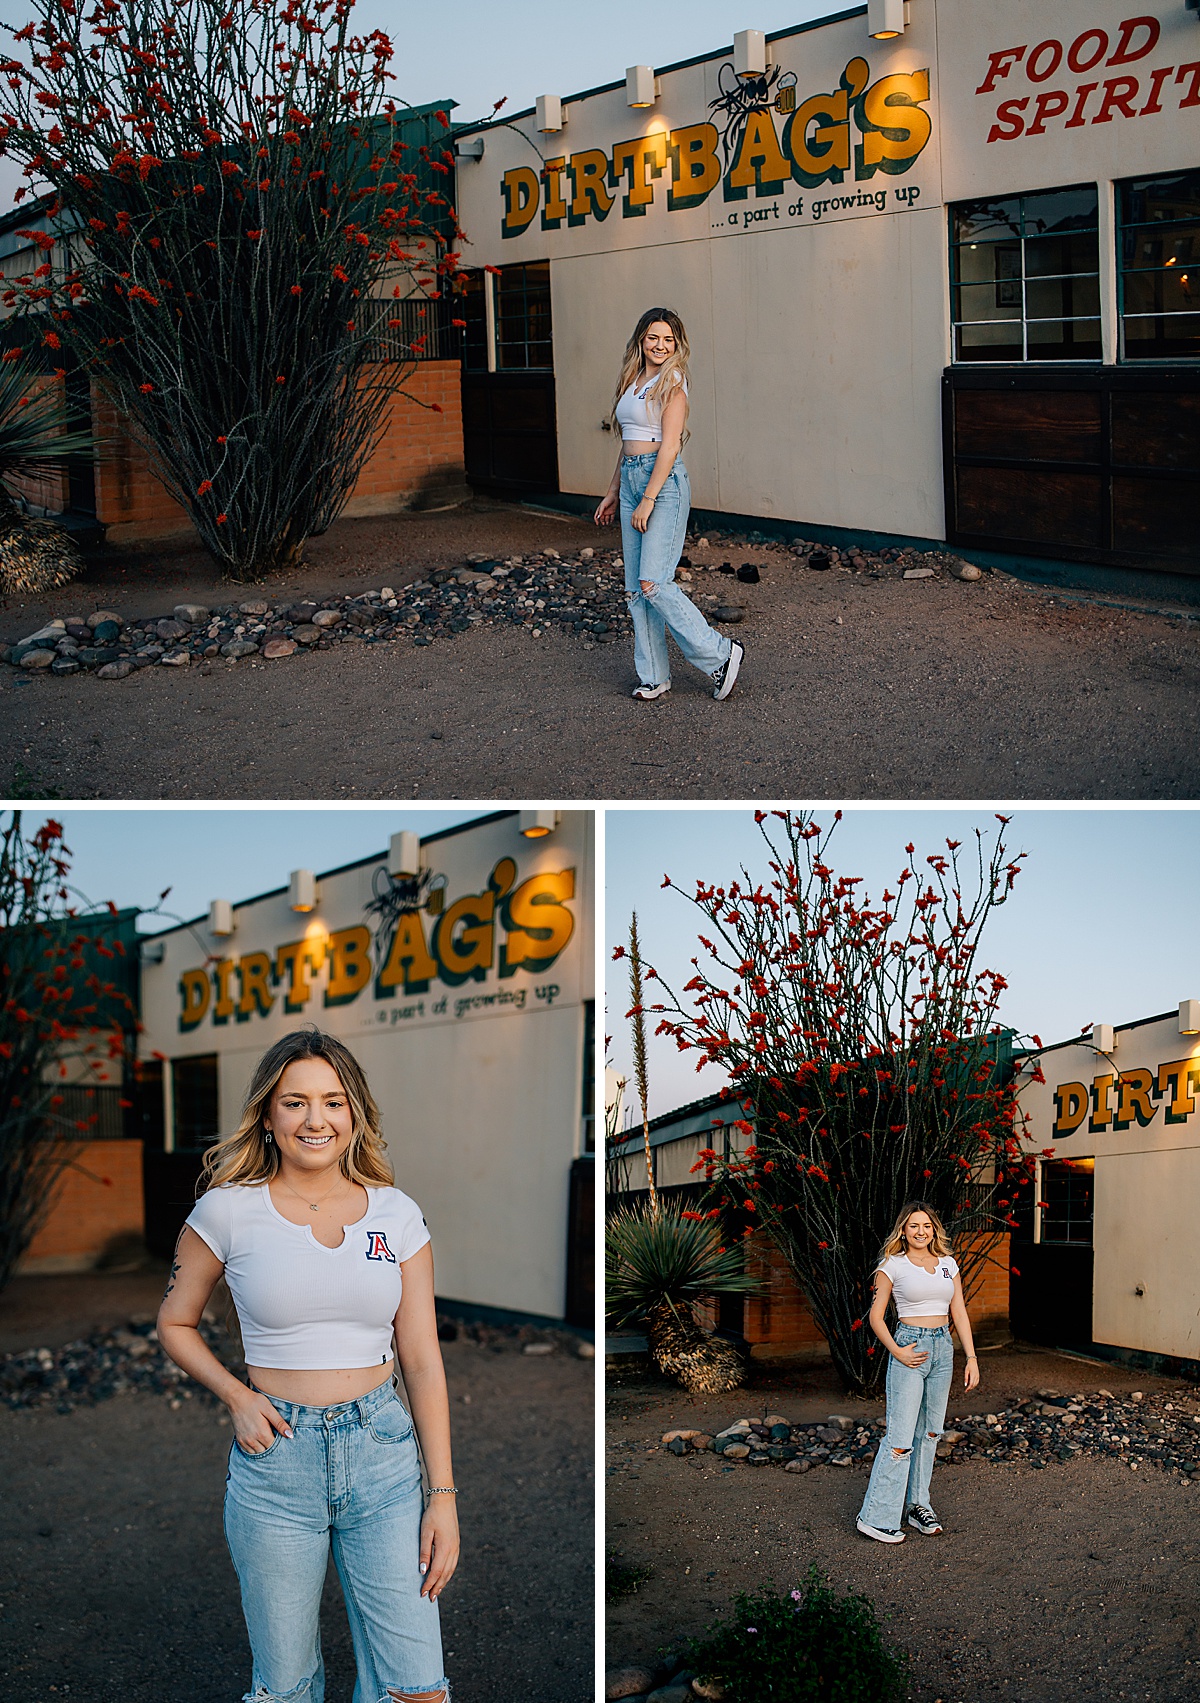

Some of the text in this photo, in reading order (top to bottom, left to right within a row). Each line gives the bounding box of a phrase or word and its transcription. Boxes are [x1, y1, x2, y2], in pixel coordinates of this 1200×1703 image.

[975, 16, 1161, 95] FOOD
[500, 56, 932, 240] DIRTBAG'S
[743, 201, 780, 228] part
[788, 197, 804, 216] of
[811, 188, 887, 220] growing
[894, 185, 921, 207] up
[178, 856, 577, 1034] DIRTBAG'S
[390, 1000, 425, 1025] part
[432, 994, 449, 1015] of
[454, 987, 527, 1019] growing
[535, 983, 561, 1005] up
[1052, 1056, 1200, 1139] DIRT
[365, 1231, 396, 1264] A
